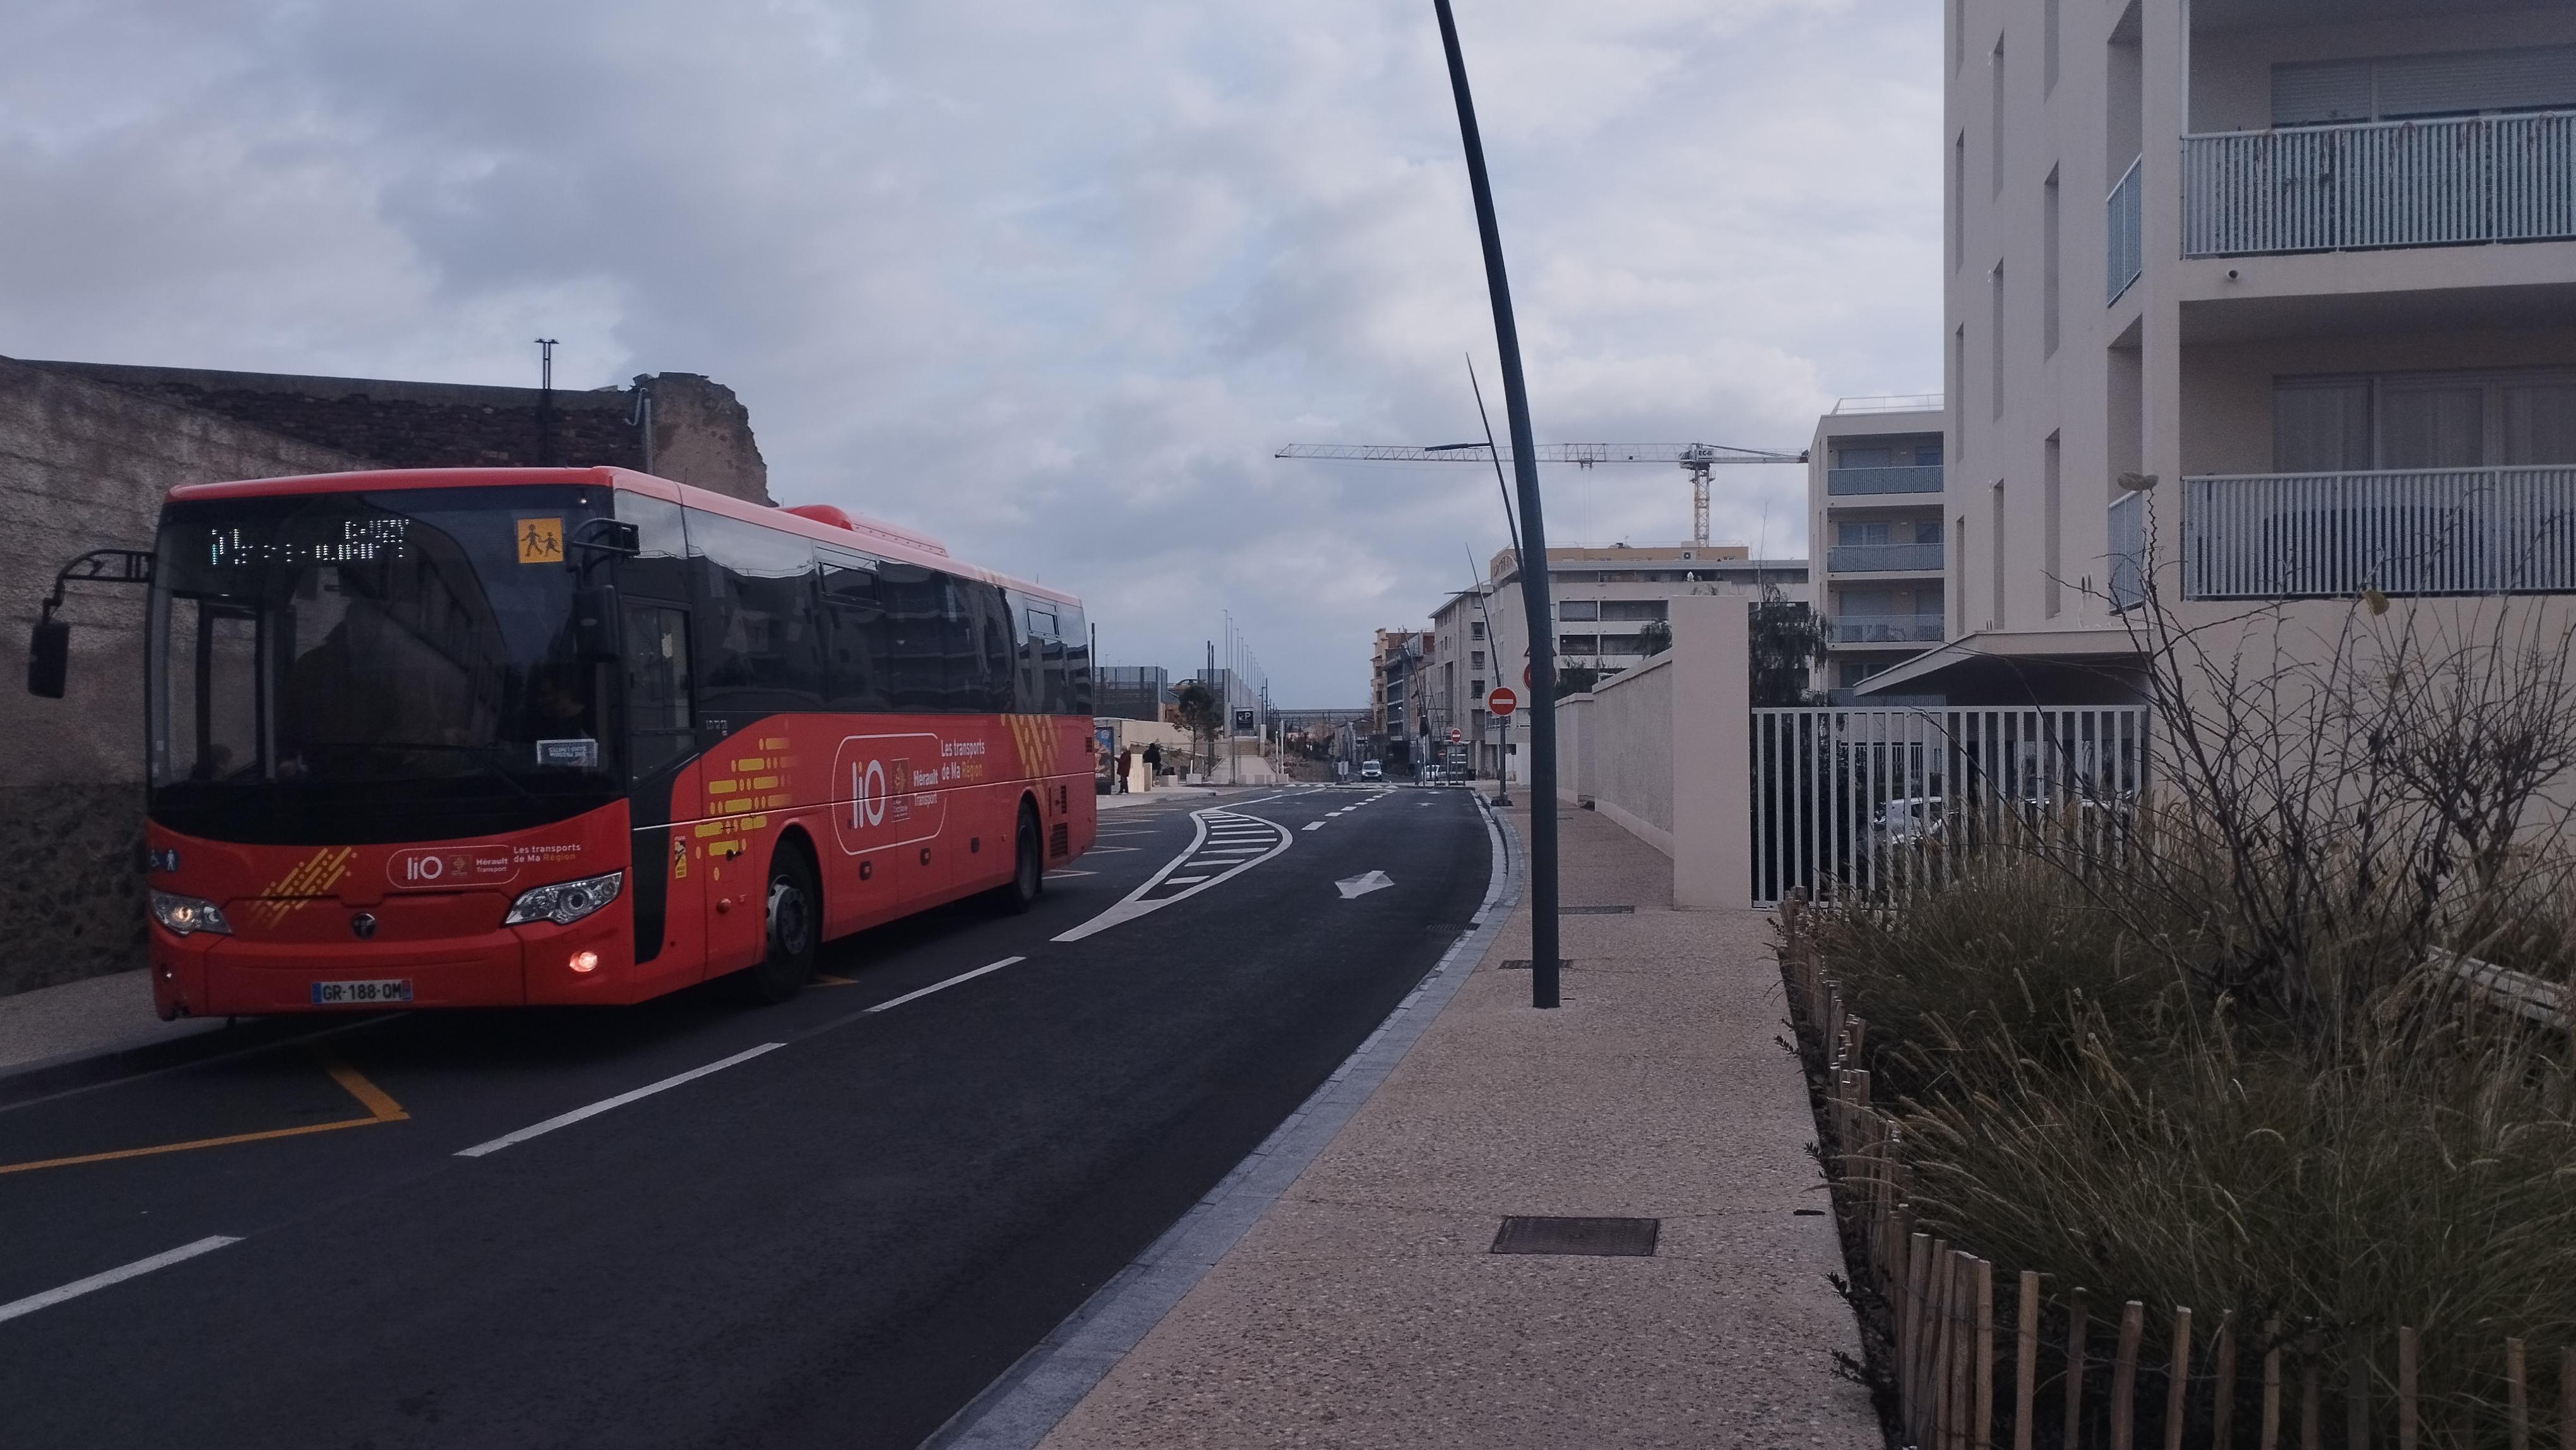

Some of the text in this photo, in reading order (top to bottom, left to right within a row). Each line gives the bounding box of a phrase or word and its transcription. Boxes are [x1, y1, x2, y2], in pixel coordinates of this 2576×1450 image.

[1244, 712, 1251, 720] P
[941, 738, 985, 757] Les transports
[914, 769, 938, 787] Hérault
[942, 760, 982, 781] de Ma Région
[915, 792, 938, 808] Transport
[532, 844, 581, 853] transports
[543, 853, 576, 861] Région
